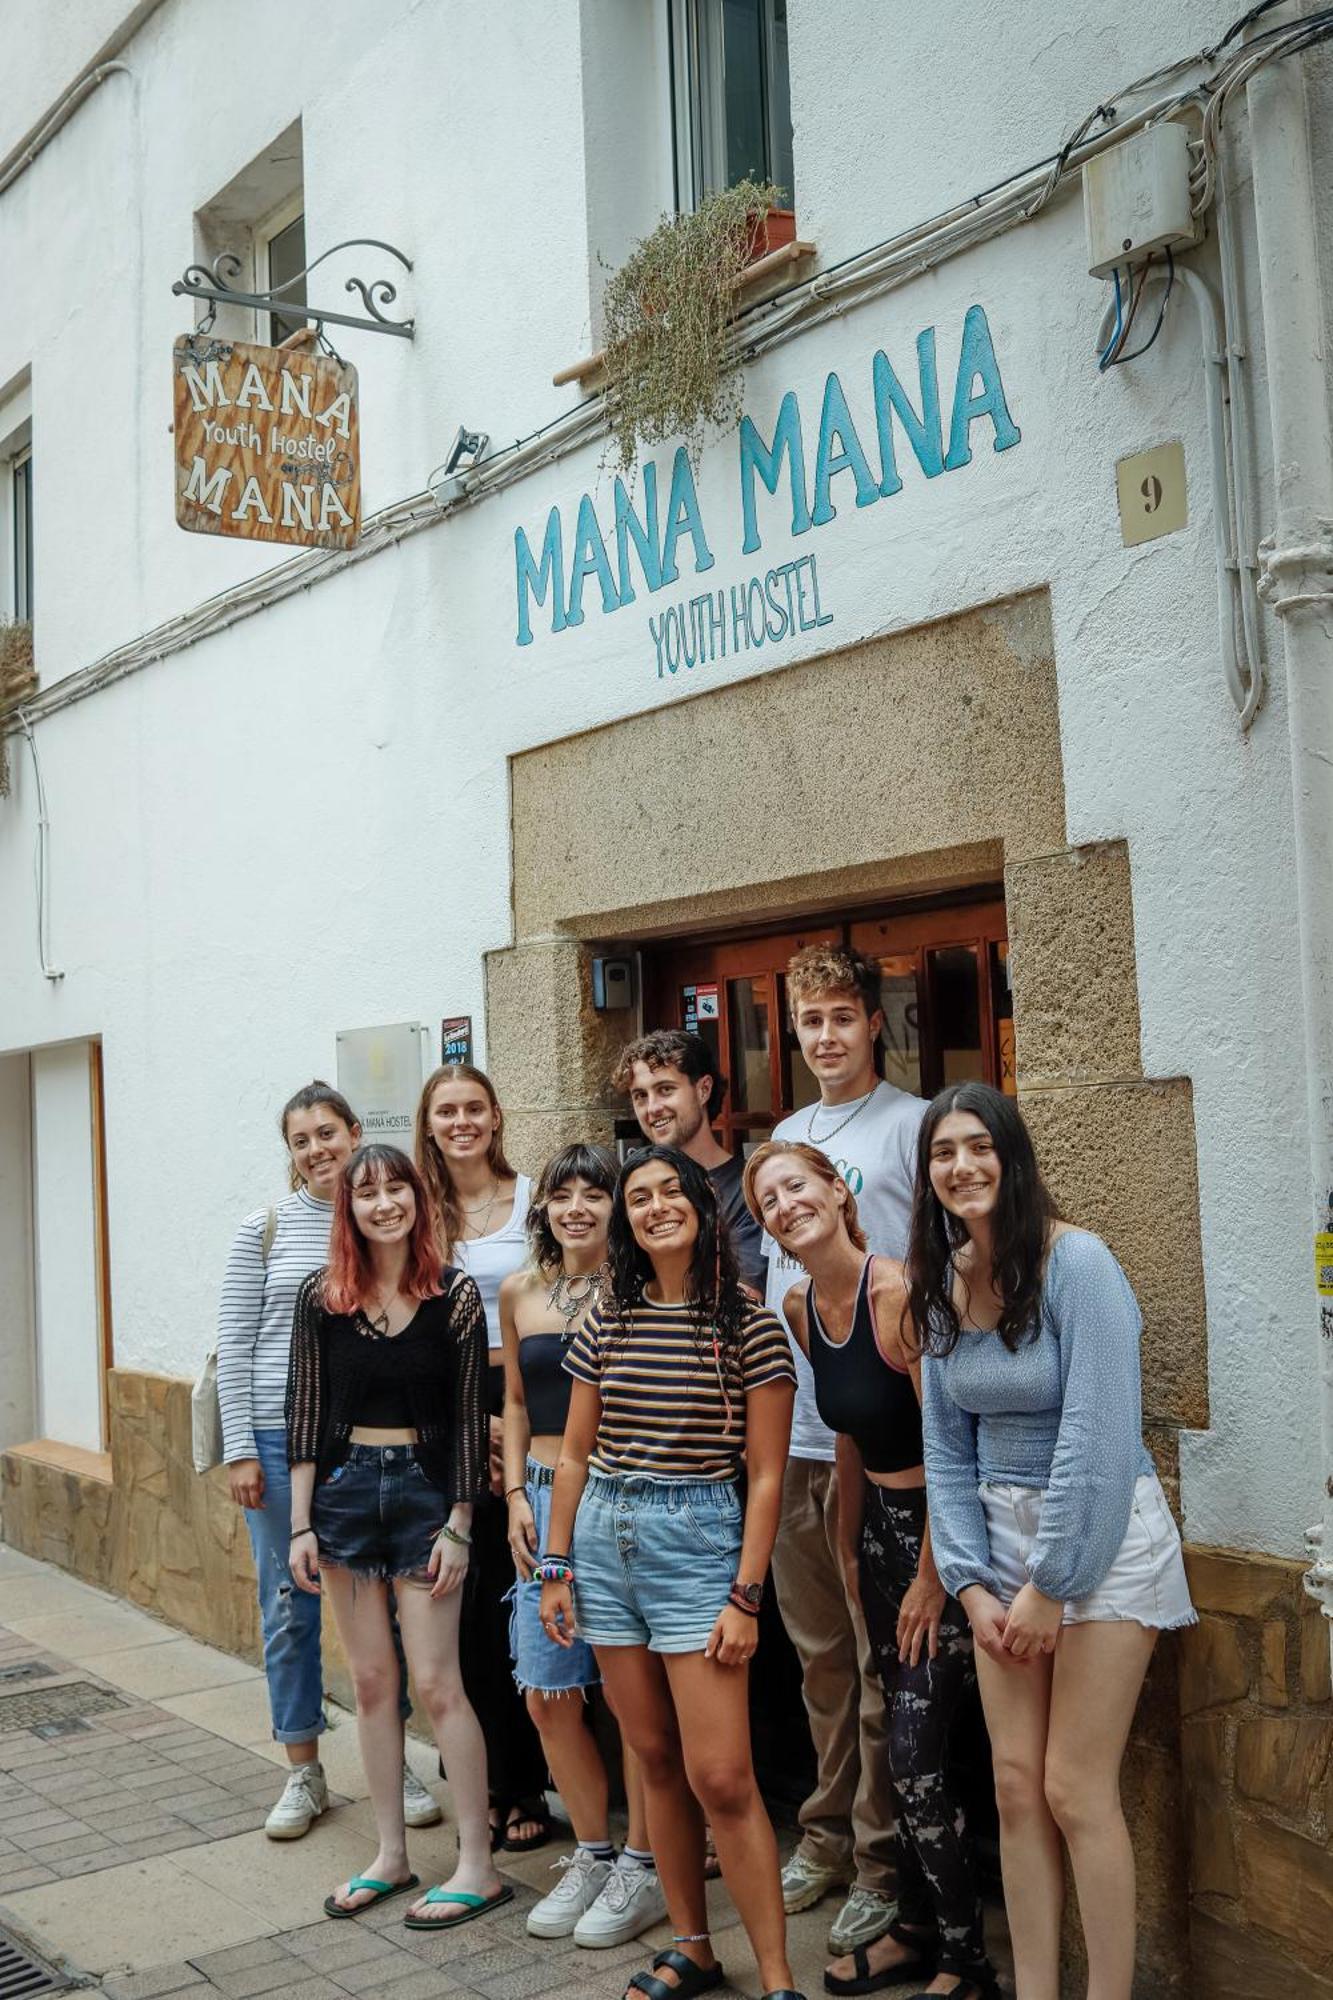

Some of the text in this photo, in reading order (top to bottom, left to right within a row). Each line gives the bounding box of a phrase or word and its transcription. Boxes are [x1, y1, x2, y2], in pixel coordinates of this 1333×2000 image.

[181, 361, 350, 439] MANA
[202, 418, 336, 464] Youth Hostel
[514, 304, 1022, 646] MANA MANA
[182, 456, 354, 531] MANA
[1141, 475, 1163, 514] 9
[648, 553, 834, 679] YOUTH HOSTEL
[366, 1116, 385, 1129] MANA
[386, 1115, 412, 1128] HOSTEL
